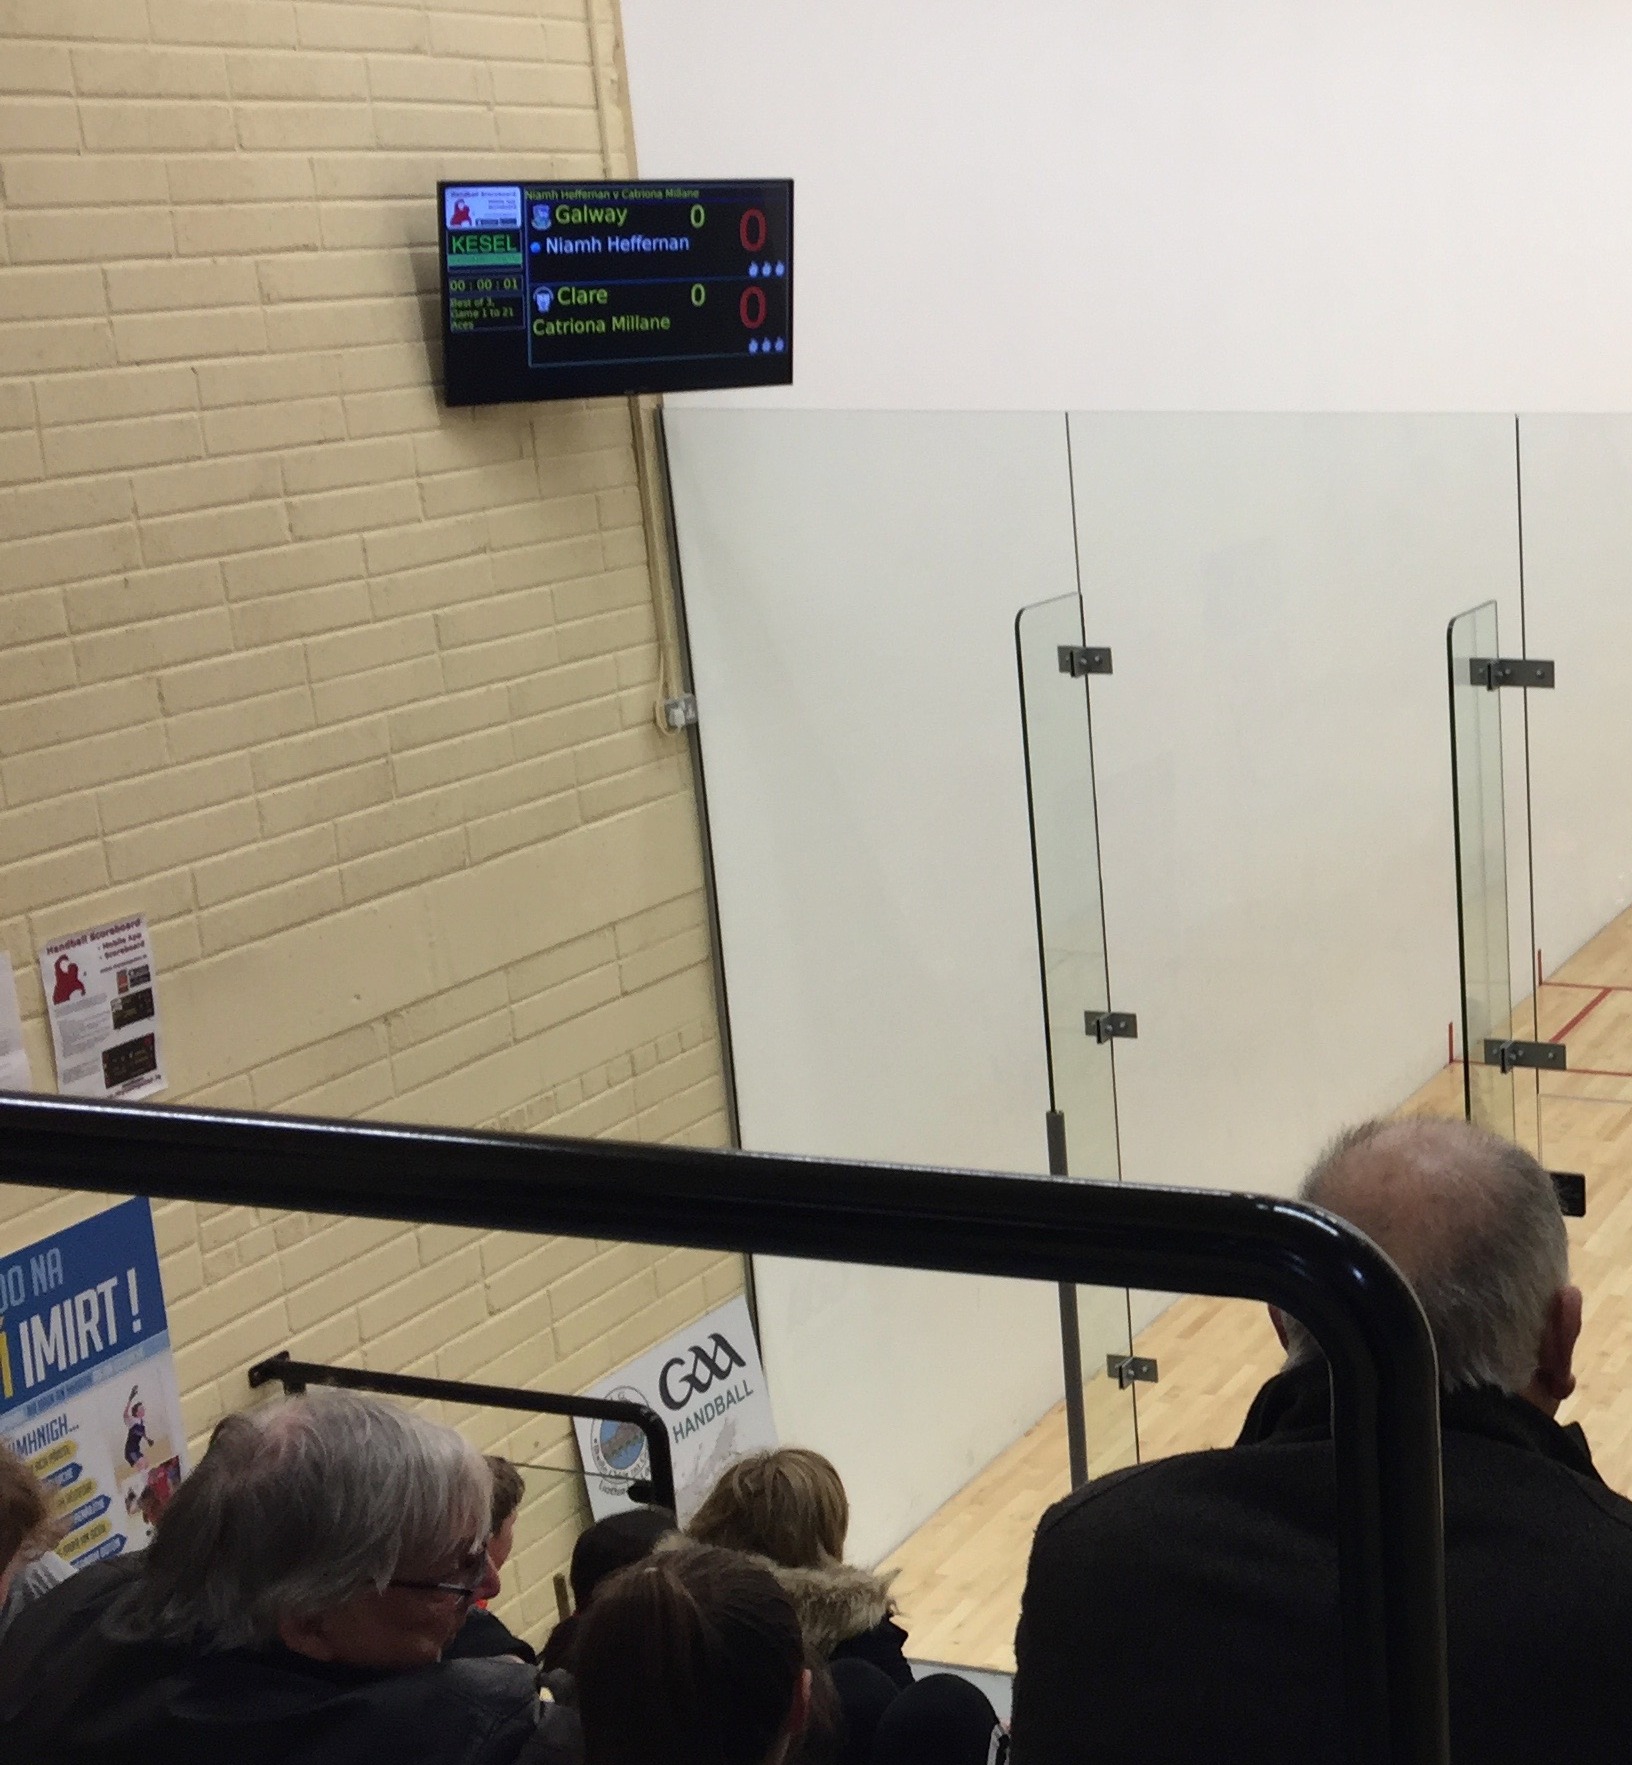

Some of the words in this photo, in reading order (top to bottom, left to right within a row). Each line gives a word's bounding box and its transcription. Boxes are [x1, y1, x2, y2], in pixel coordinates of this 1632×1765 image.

[555, 204, 628, 227] Galway
[690, 204, 705, 229] 0
[740, 208, 767, 252] 0
[452, 234, 517, 254] KESEL
[546, 236, 602, 254] Niamh
[608, 234, 690, 252] Heffernan
[557, 286, 608, 305] Clare
[691, 283, 706, 307] 0
[740, 286, 767, 329] 0
[533, 318, 606, 336] Catriona
[612, 315, 671, 332] Millane
[29, 1247, 64, 1297] NA
[672, 1379, 754, 1444] HANDBALL
